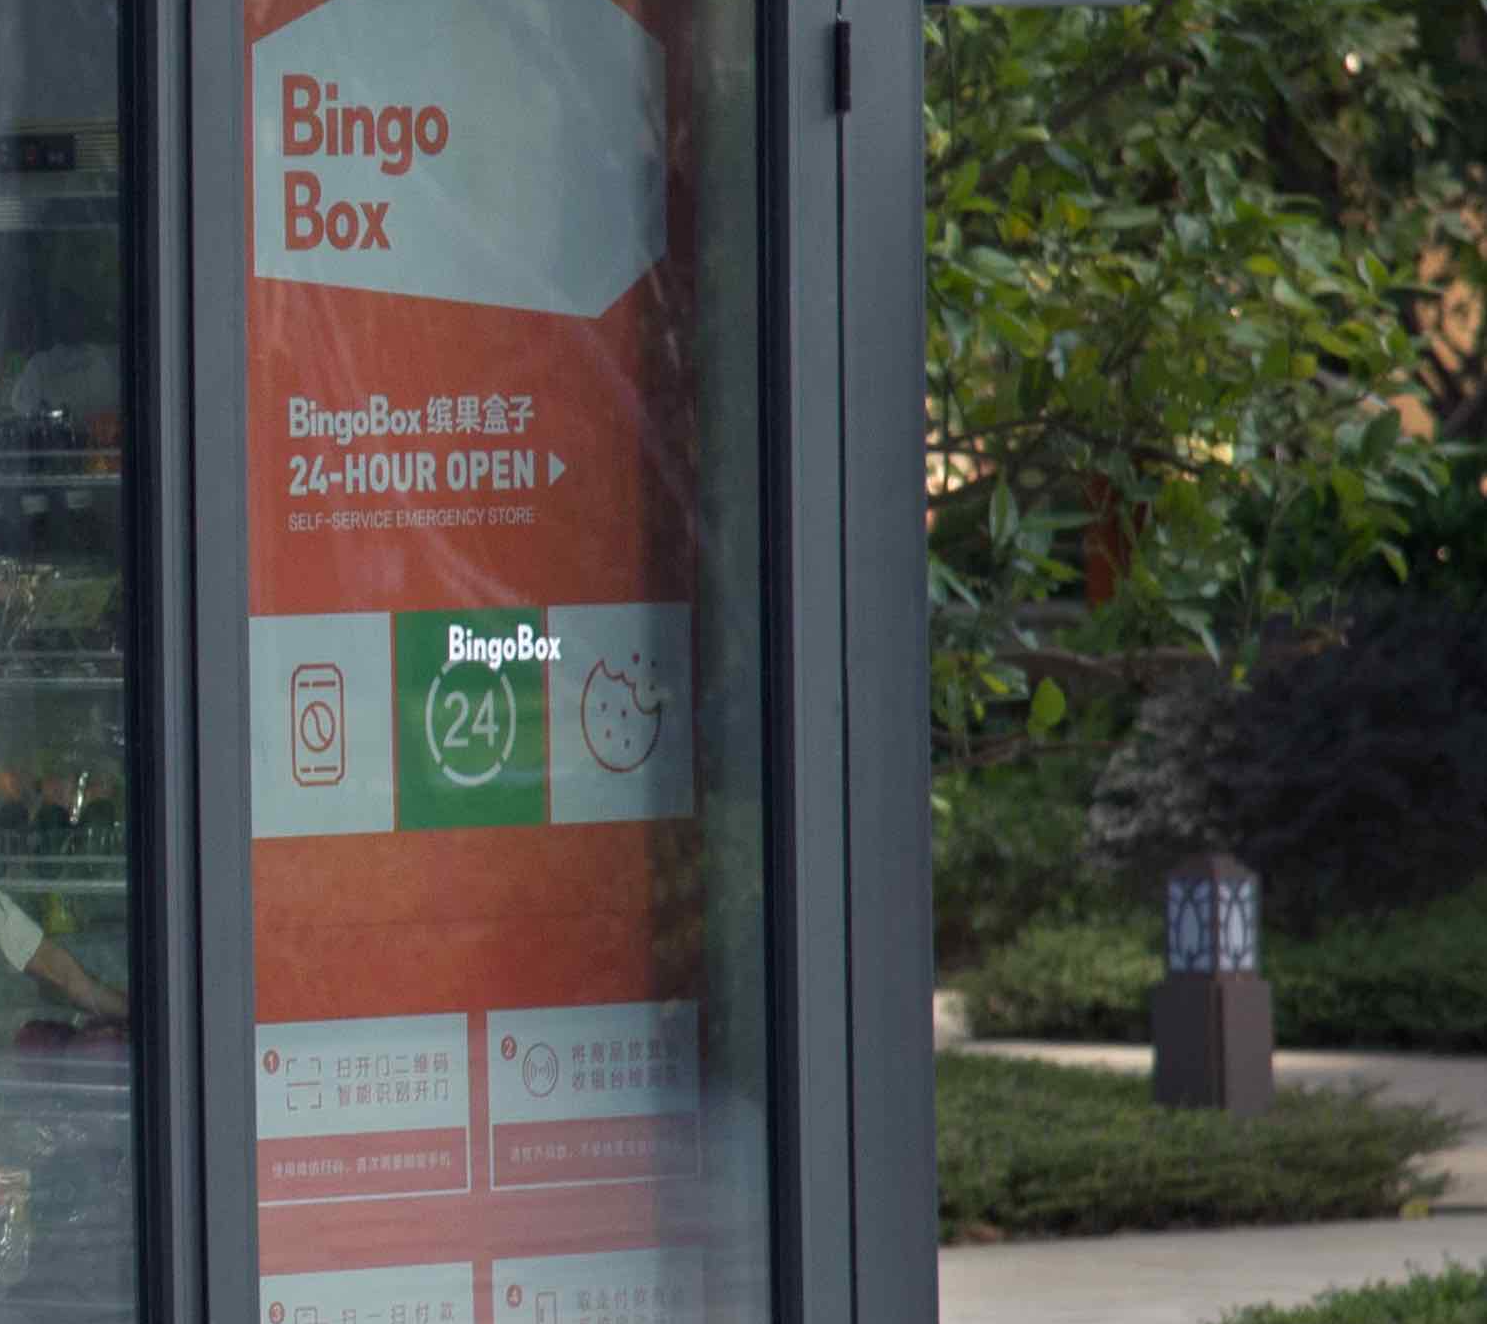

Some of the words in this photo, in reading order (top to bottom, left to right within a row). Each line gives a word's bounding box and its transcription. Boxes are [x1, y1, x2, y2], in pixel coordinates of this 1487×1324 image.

[282, 73, 449, 176] Bingo
[283, 171, 392, 252] Box
[289, 395, 422, 445] BingoBox
[427, 393, 535, 435] 缤果盒子
[288, 452, 437, 496] 24-HOUR
[446, 450, 536, 492] OPEN
[288, 509, 392, 533] SELF-SERVICE
[396, 508, 485, 529] EMERGENCY
[489, 506, 535, 527] STORE
[449, 624, 562, 670] BingoBox
[443, 689, 499, 748] 24
